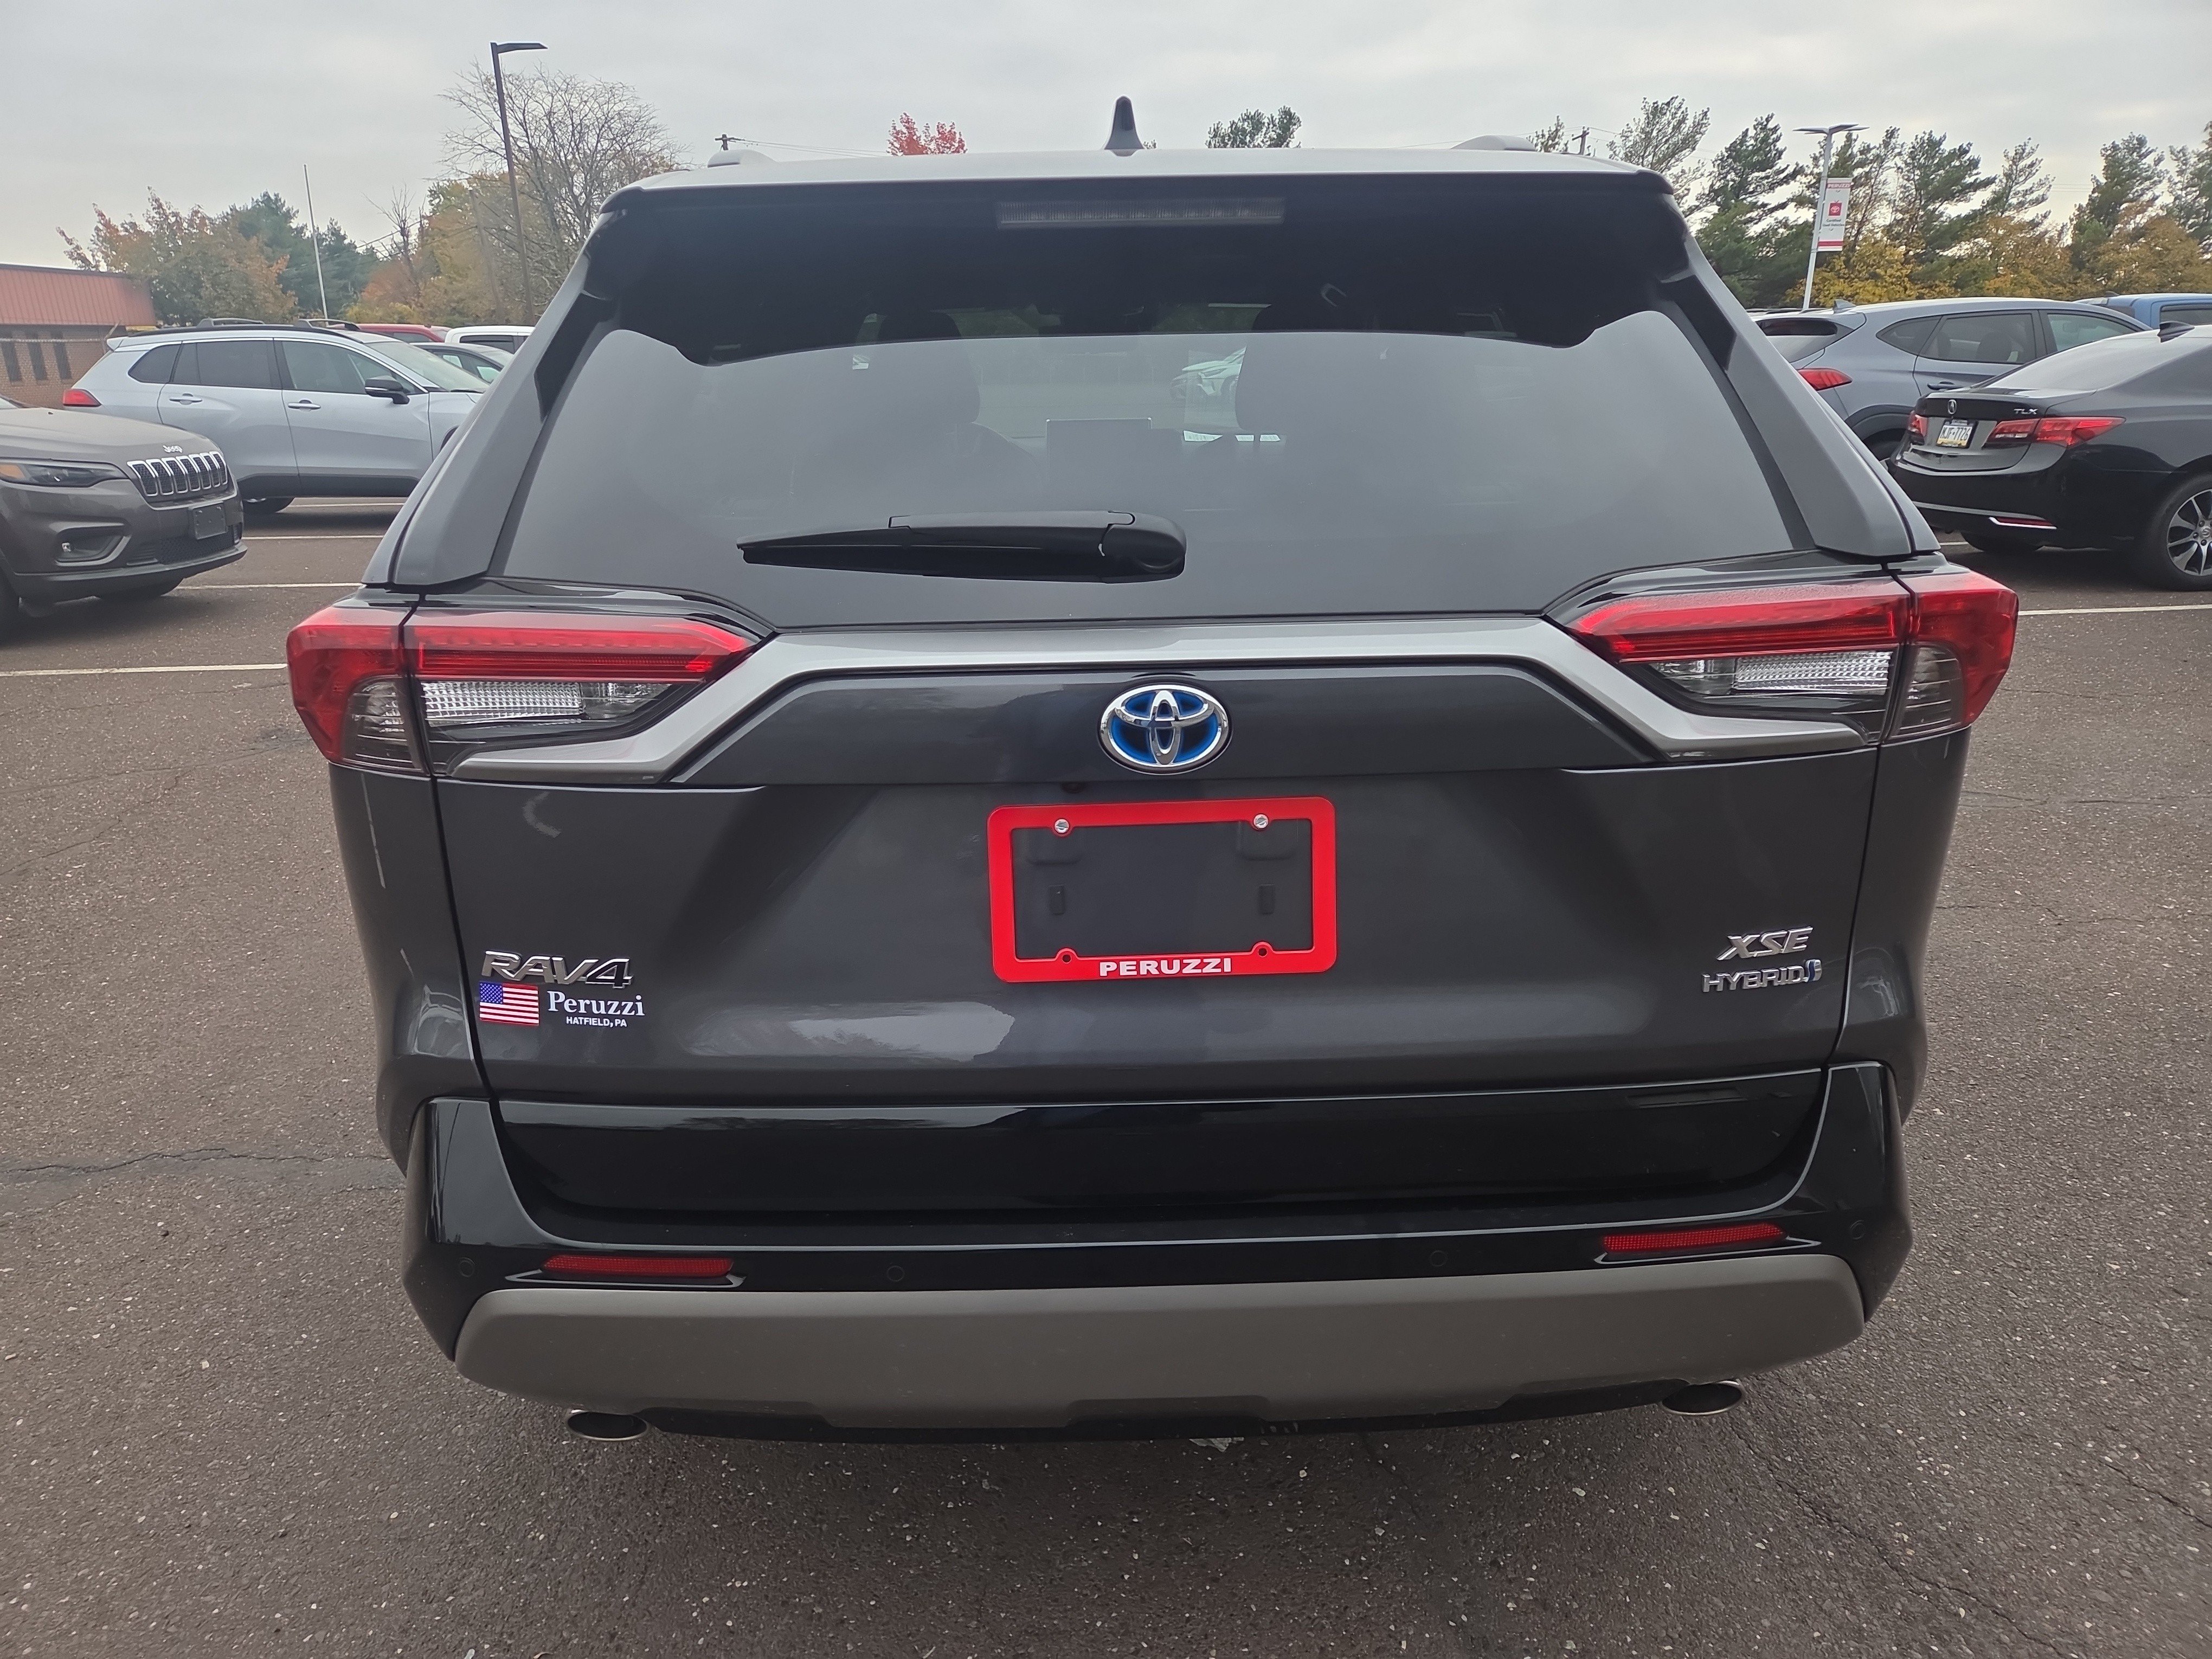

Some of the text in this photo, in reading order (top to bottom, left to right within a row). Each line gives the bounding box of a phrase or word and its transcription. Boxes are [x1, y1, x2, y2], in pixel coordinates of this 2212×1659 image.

[162, 445, 183, 453] Jeep
[1716, 925, 1814, 961] XSE
[481, 950, 633, 989] RAV4
[1099, 957, 1231, 976] PERUZZI
[1702, 964, 1805, 992] HYBRID
[546, 990, 645, 1016] Peruzzi
[565, 1016, 628, 1028] HATFIELD, PA
